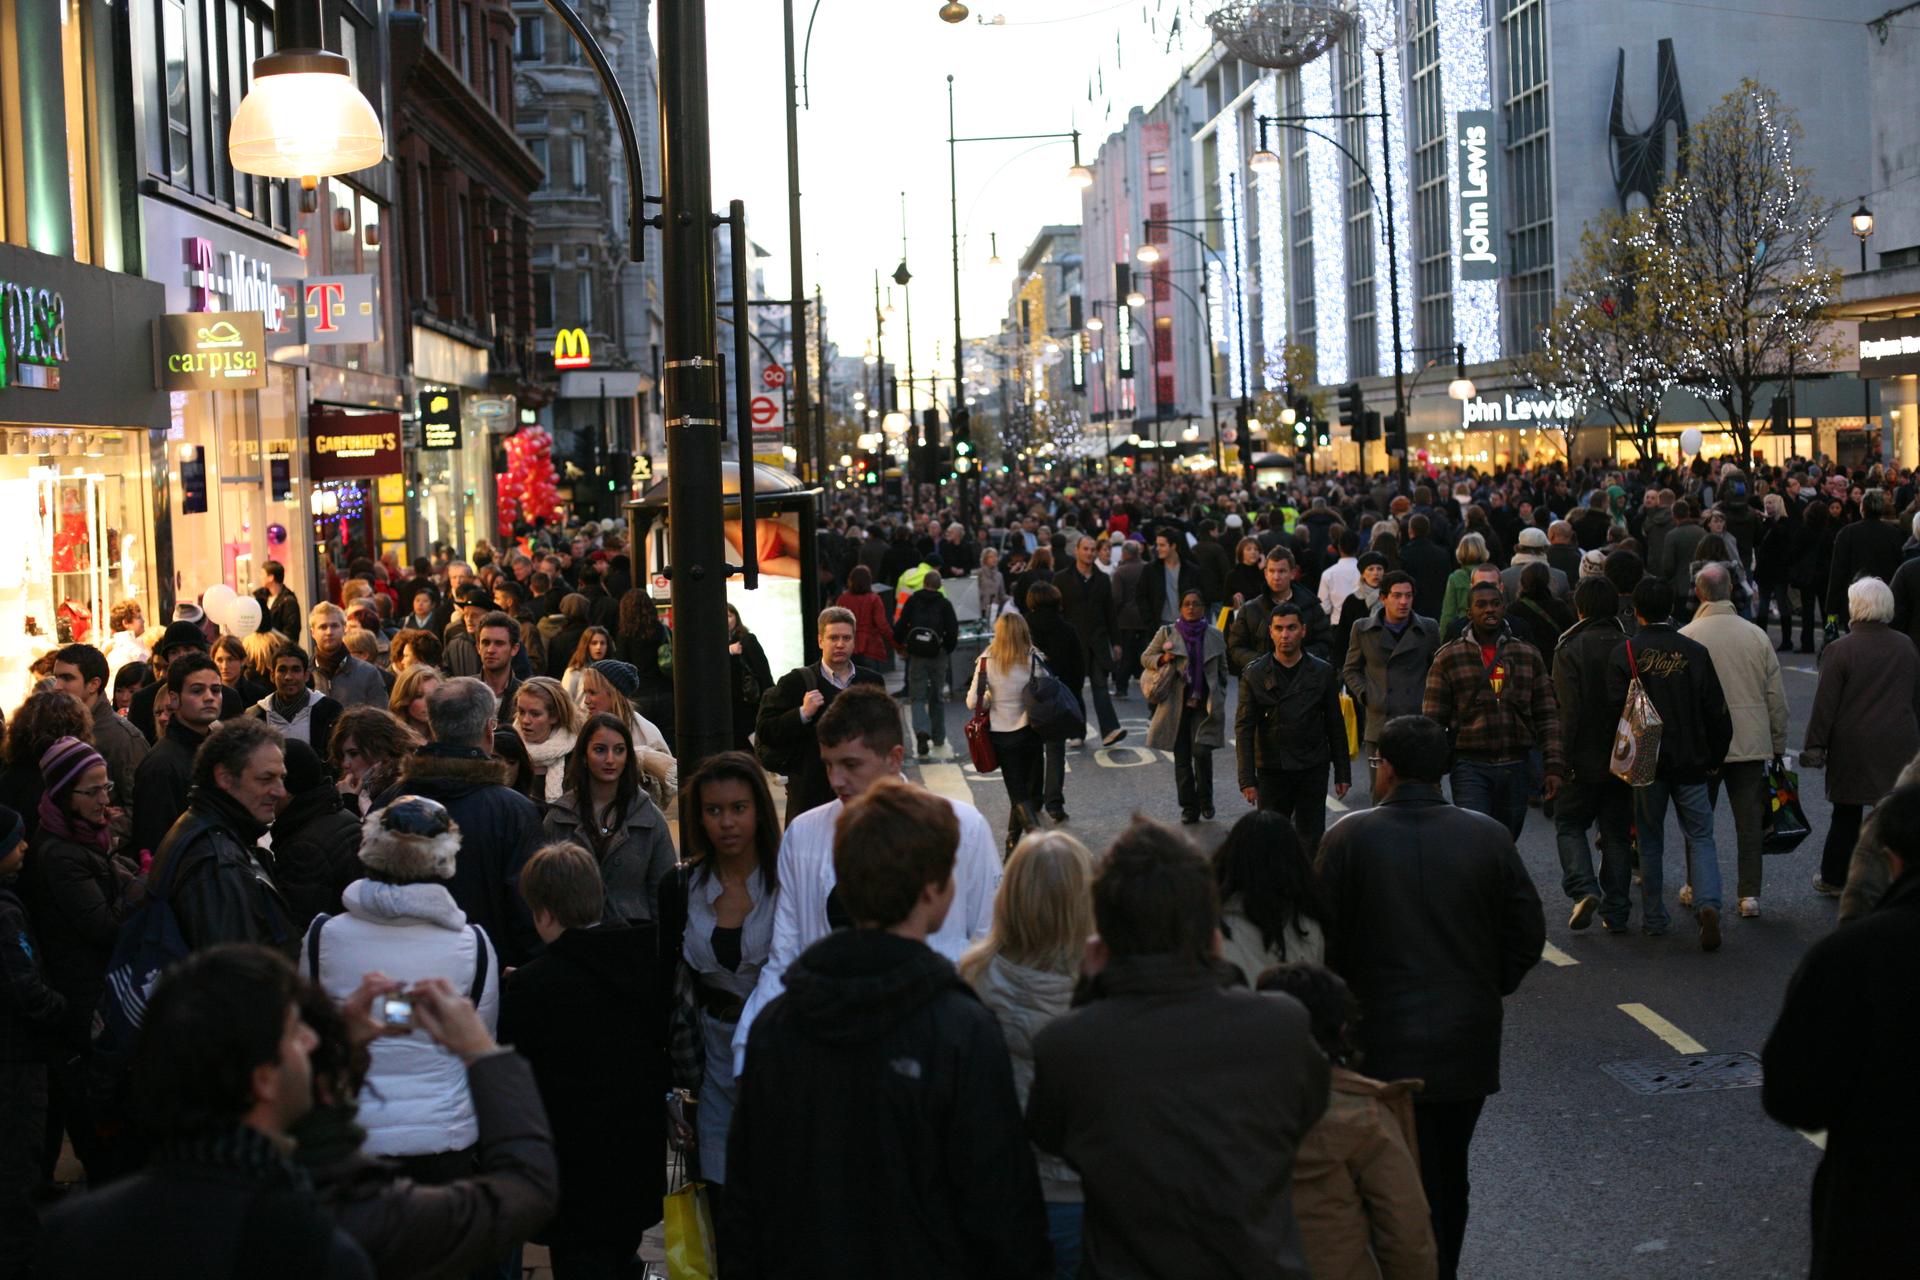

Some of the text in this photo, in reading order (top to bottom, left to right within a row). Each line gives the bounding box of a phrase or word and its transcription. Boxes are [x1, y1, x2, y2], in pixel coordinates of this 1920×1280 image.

[1460, 126, 1497, 264] John Lewis
[168, 350, 258, 378] carpisa
[1462, 393, 1575, 429] John Lewis
